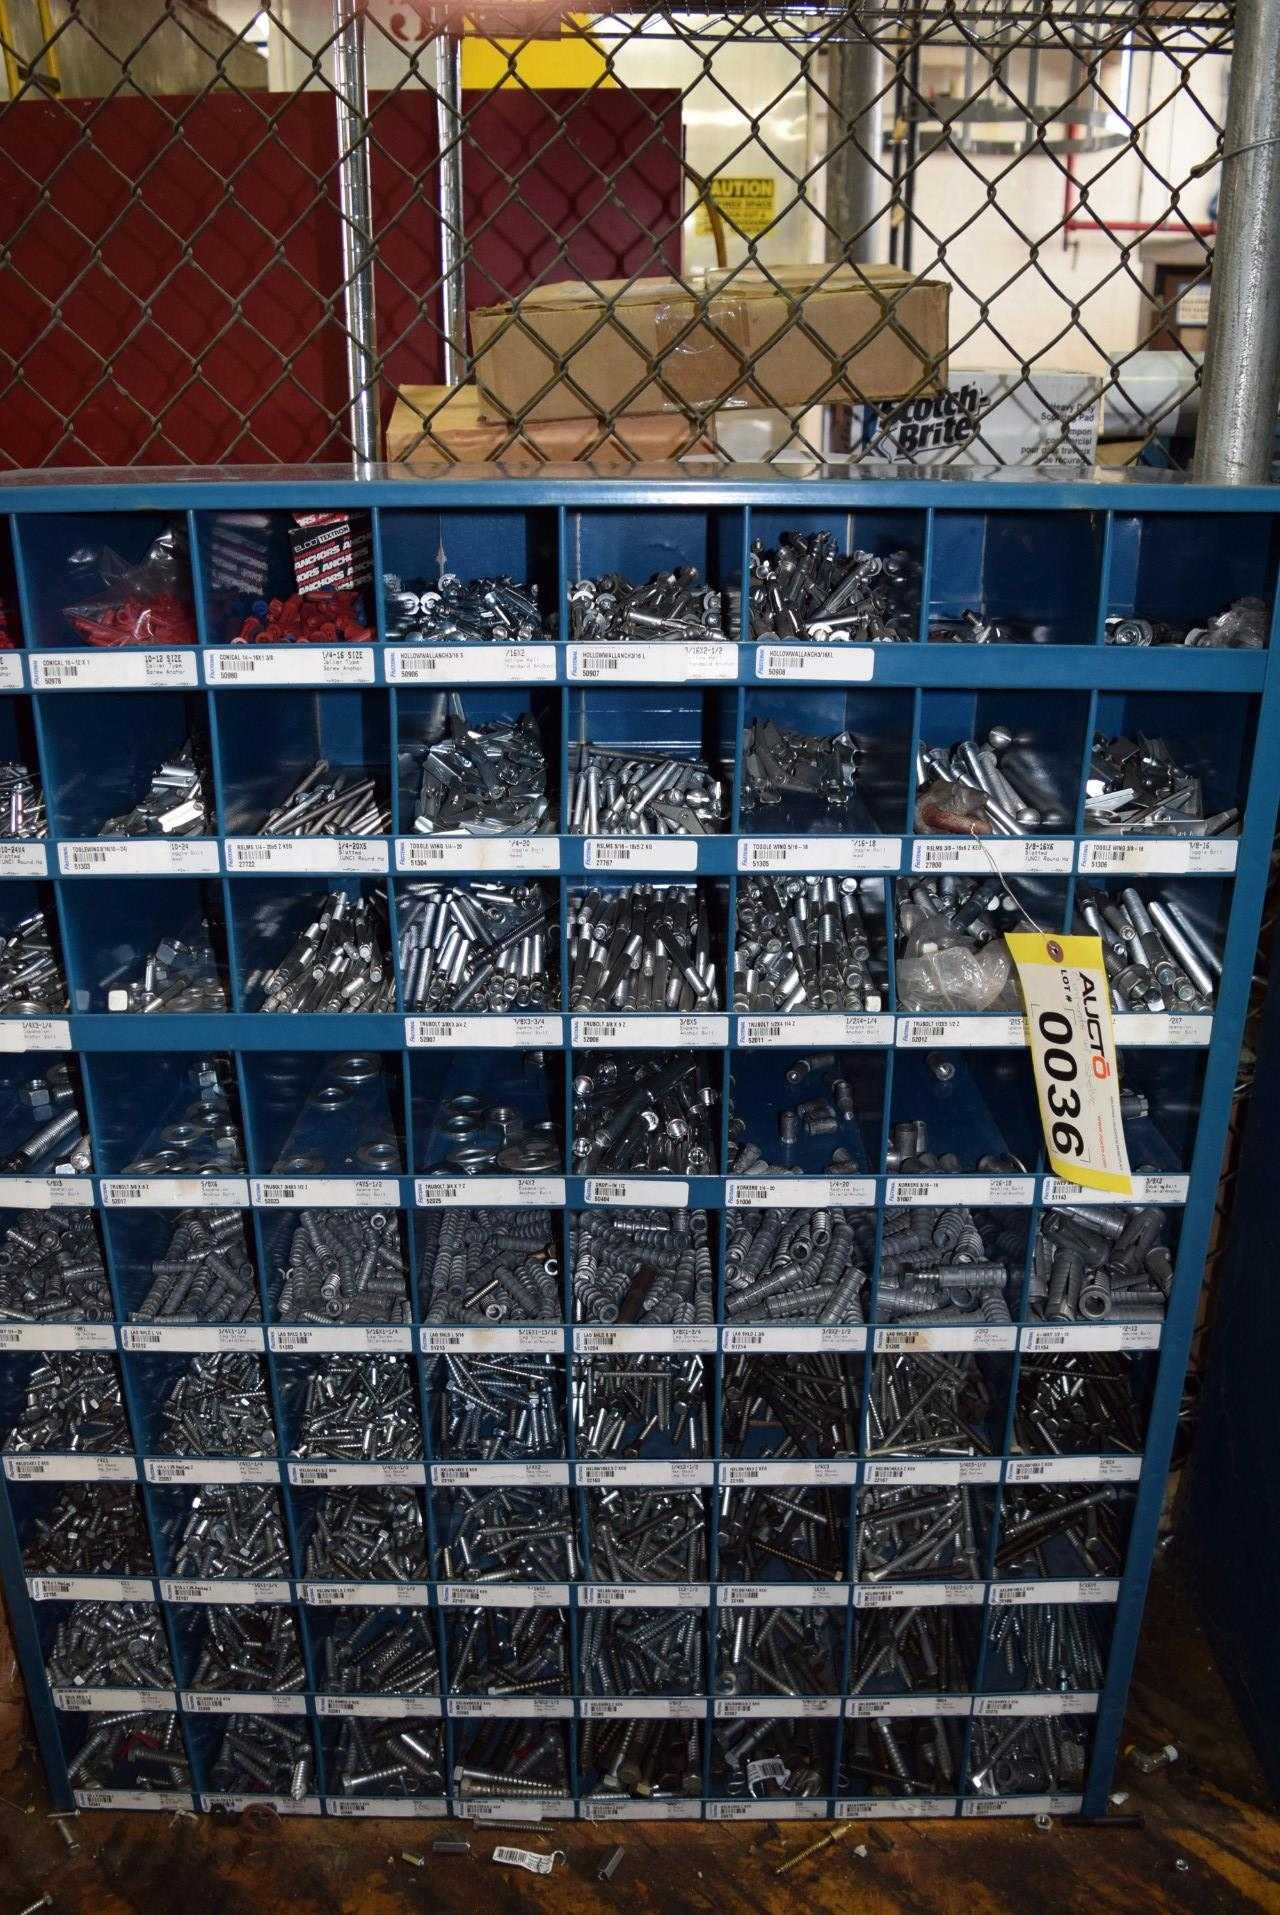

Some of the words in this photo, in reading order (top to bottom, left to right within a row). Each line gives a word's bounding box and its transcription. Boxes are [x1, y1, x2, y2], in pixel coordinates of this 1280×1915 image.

[709, 179, 773, 197] AUTION
[898, 414, 975, 454] Brite
[319, 525, 349, 543] TEXTRON
[294, 545, 341, 570] ANCHORS
[299, 571, 345, 596] ANCHORS
[219, 653, 240, 661] CONICAL
[348, 651, 364, 659] SIZE
[505, 649, 525, 657] /16X2
[145, 655, 166, 663] 10-12
[166, 654, 182, 663] SIZE
[401, 670, 418, 678] 50906
[768, 668, 785, 676] 50908
[338, 842, 367, 851] 1/4-20X5
[1025, 842, 1054, 850] 3/8-16X6
[1061, 969, 1071, 992] LOT
[679, 1018, 697, 1026] 3/8X5
[846, 1017, 877, 1025] 1/2X4-1/4
[1038, 1010, 1085, 1158] 0036
